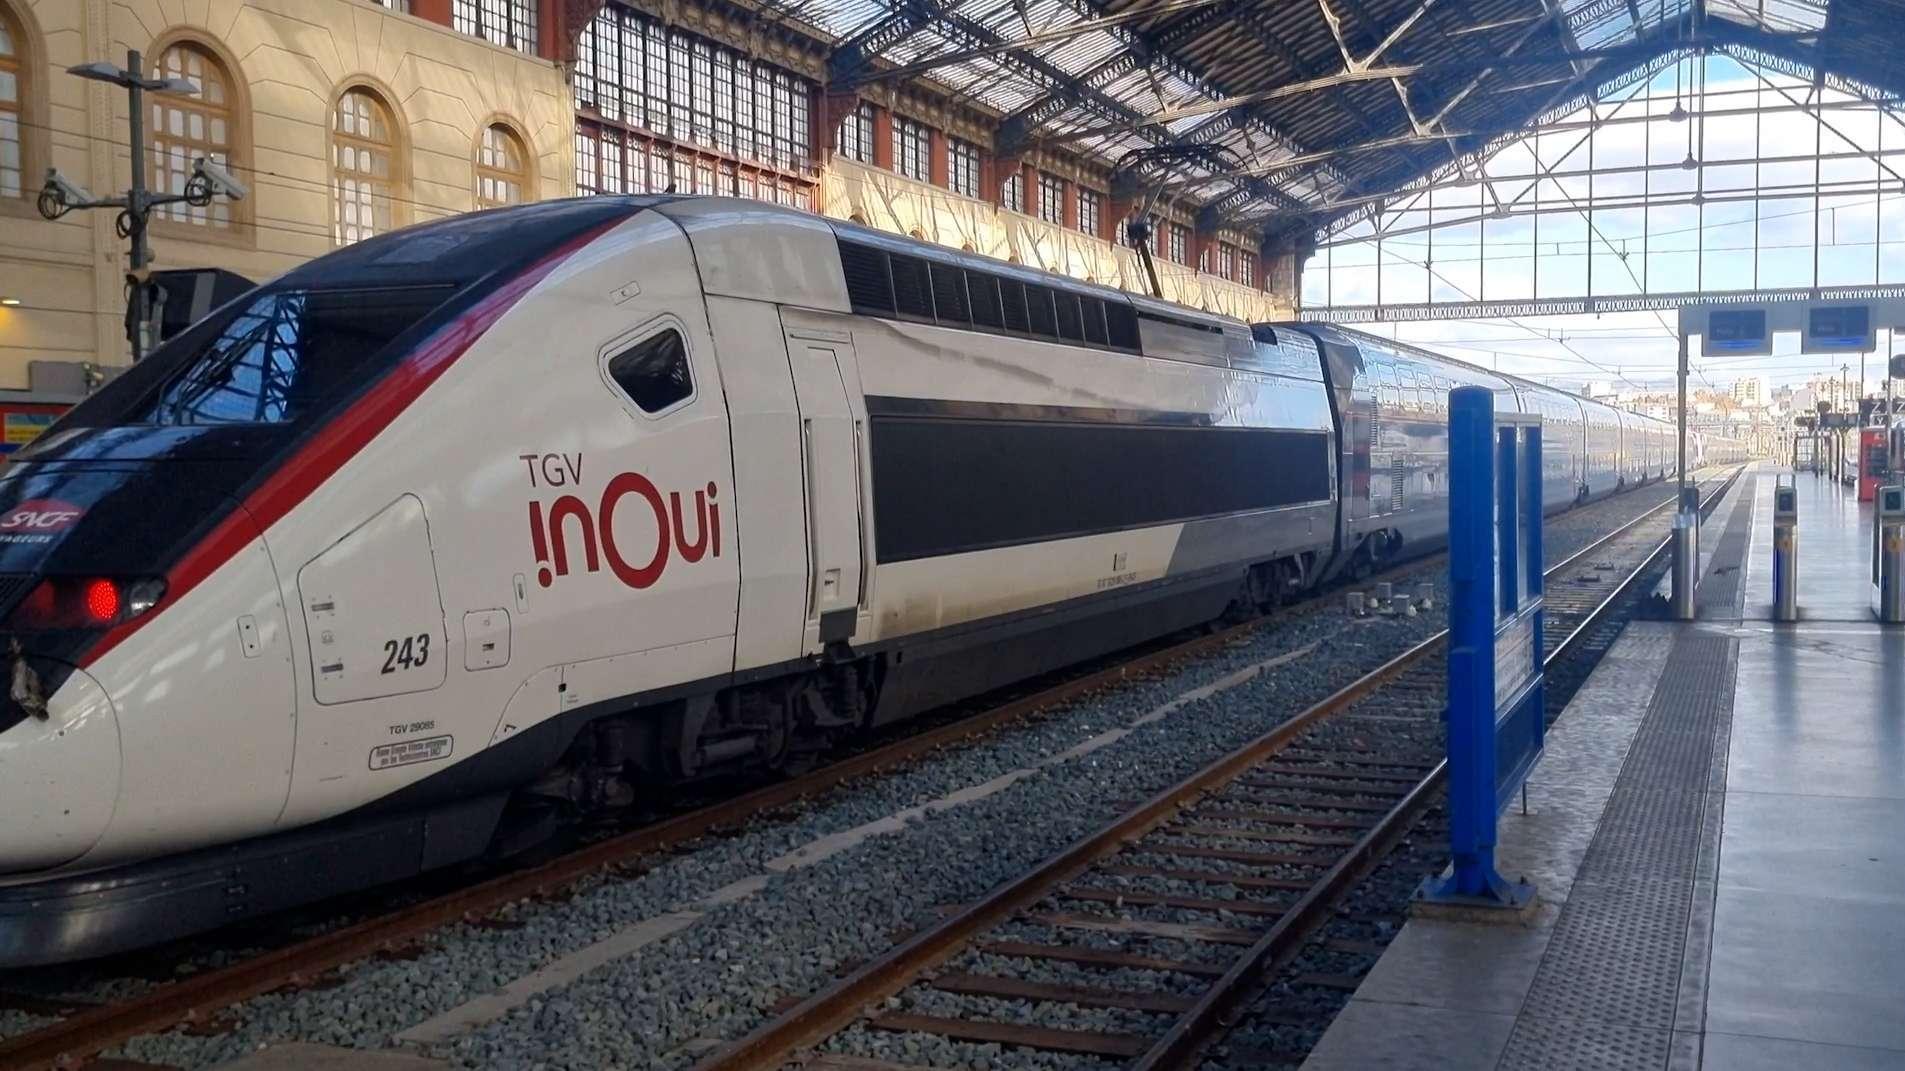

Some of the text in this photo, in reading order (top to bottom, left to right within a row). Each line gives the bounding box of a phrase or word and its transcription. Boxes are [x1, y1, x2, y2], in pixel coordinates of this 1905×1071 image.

[519, 453, 582, 487] TGV
[1, 511, 80, 527] SNCF
[380, 633, 430, 675] 243
[389, 724, 409, 735] TGV
